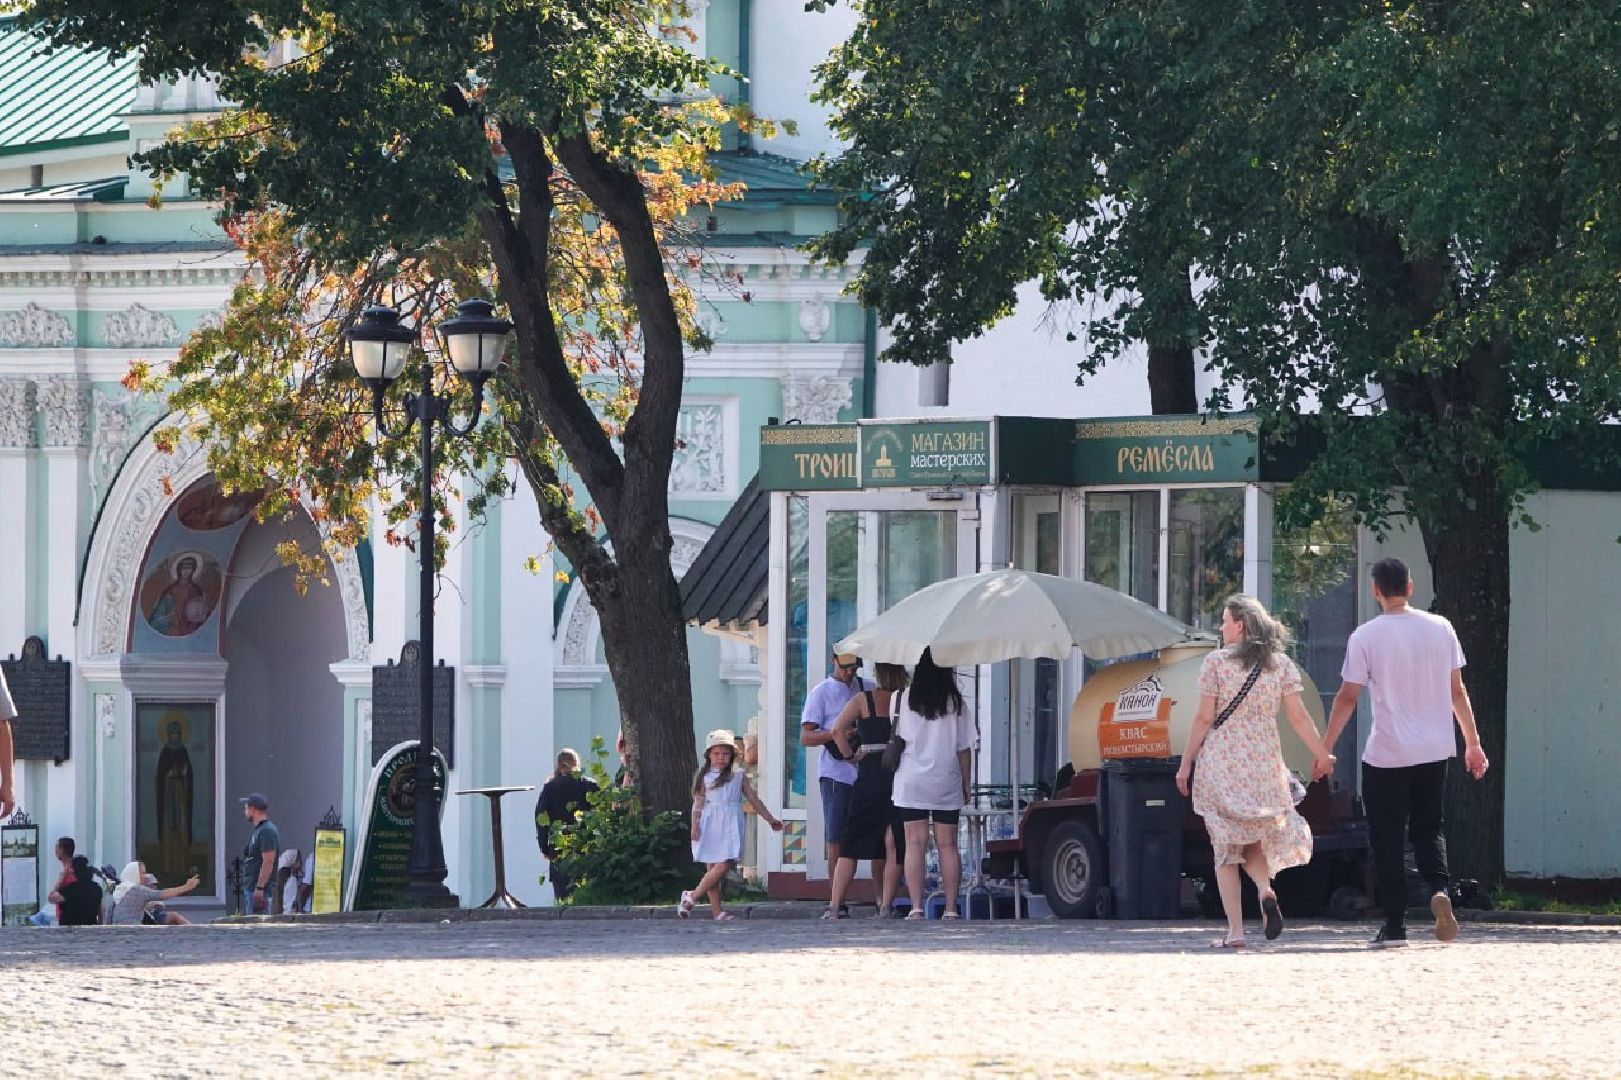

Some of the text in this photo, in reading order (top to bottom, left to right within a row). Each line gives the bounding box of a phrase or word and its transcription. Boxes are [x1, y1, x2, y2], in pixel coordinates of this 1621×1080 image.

[911, 431, 985, 452] МАГАЗИН
[1117, 440, 1215, 473] РЕМЁСЛА
[1119, 726, 1148, 739] КВАС
